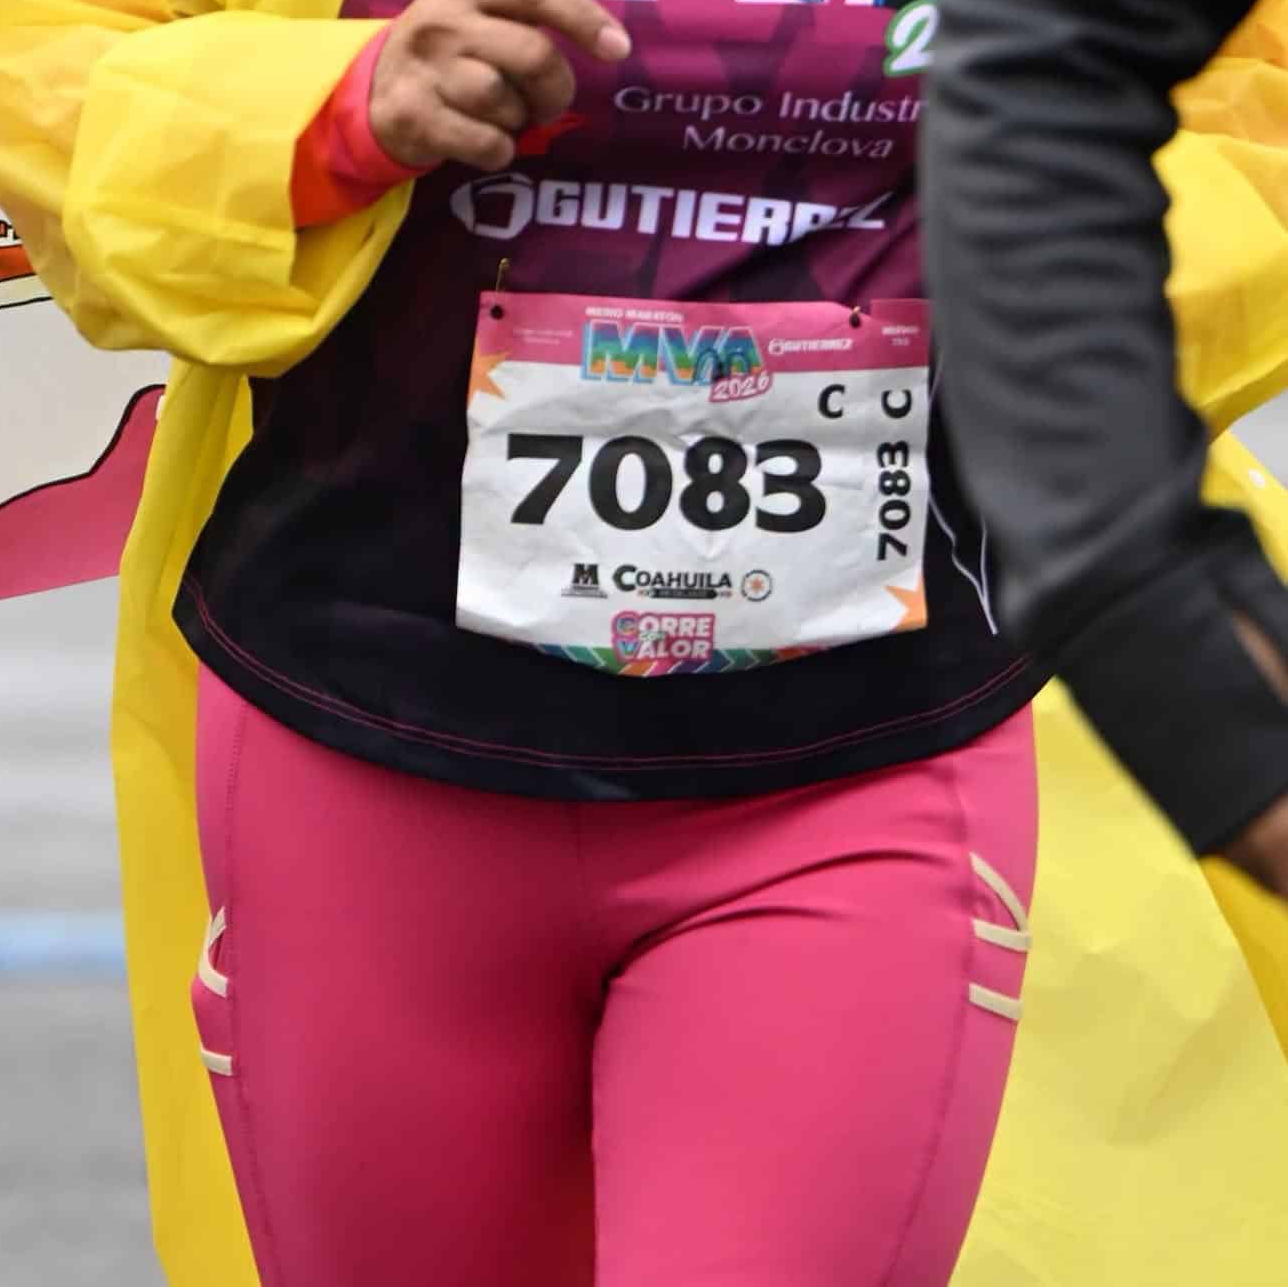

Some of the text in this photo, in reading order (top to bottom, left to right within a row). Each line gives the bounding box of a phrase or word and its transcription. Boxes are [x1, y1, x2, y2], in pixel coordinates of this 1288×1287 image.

[613, 85, 925, 124] Grupo Industr
[682, 124, 894, 159] Monclova
[581, 319, 766, 387] MVA
[711, 372, 771, 401] 2026
[818, 384, 846, 419] C
[506, 432, 827, 533] 7083
[876, 389, 913, 562] 7083 C
[612, 564, 733, 592] COAHUILA
[616, 615, 713, 637] CORRE
[617, 636, 711, 660] VALOR
